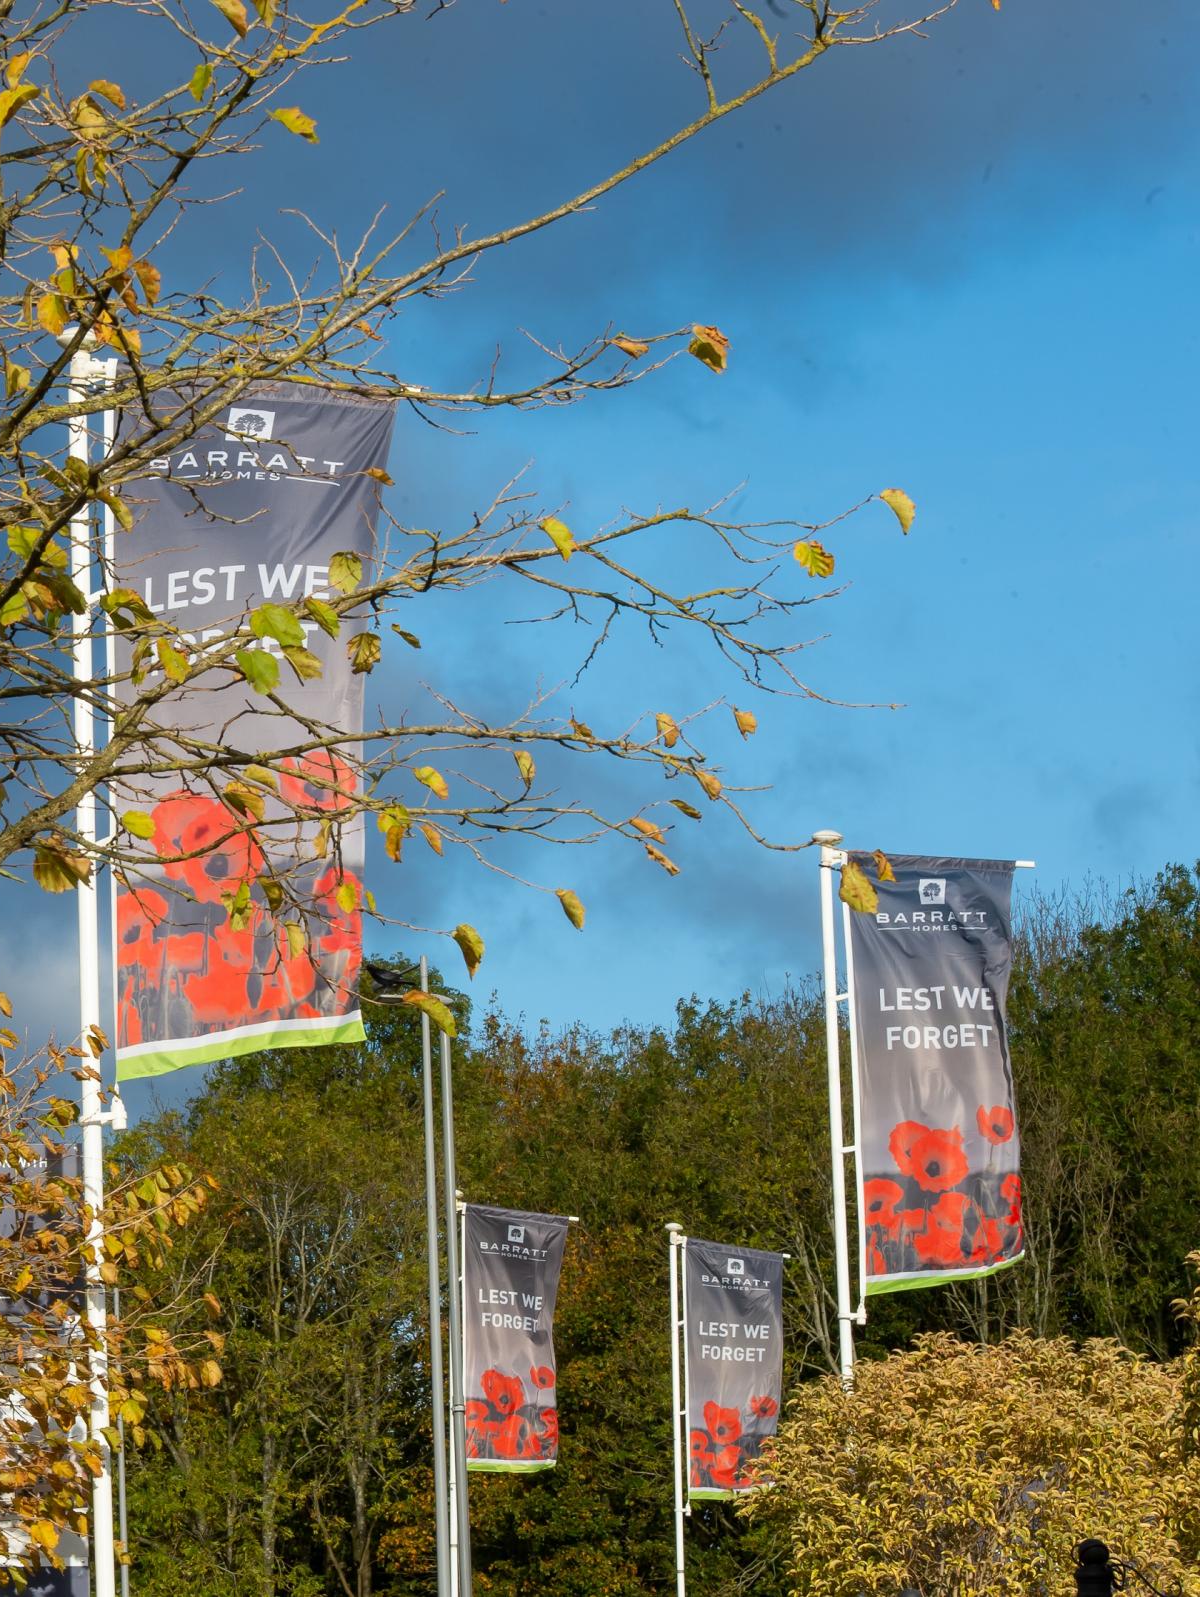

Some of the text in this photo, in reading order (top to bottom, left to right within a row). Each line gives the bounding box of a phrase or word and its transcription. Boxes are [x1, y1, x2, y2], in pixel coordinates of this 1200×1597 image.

[205, 471, 281, 481] HOMES
[145, 563, 330, 613] LEST WE
[876, 911, 987, 924] BARRATT
[913, 924, 958, 932] HOMES
[879, 985, 995, 1012] LEST WE
[886, 1023, 993, 1050] FORGET
[480, 1241, 548, 1258] BARRATT
[501, 1252, 528, 1260] HOMES
[701, 1274, 771, 1288] BARRATT
[478, 1288, 543, 1311] LEST WE
[481, 1312, 539, 1333] FORGET
[698, 1320, 770, 1340] LEST WE
[701, 1344, 767, 1363] FORGET
